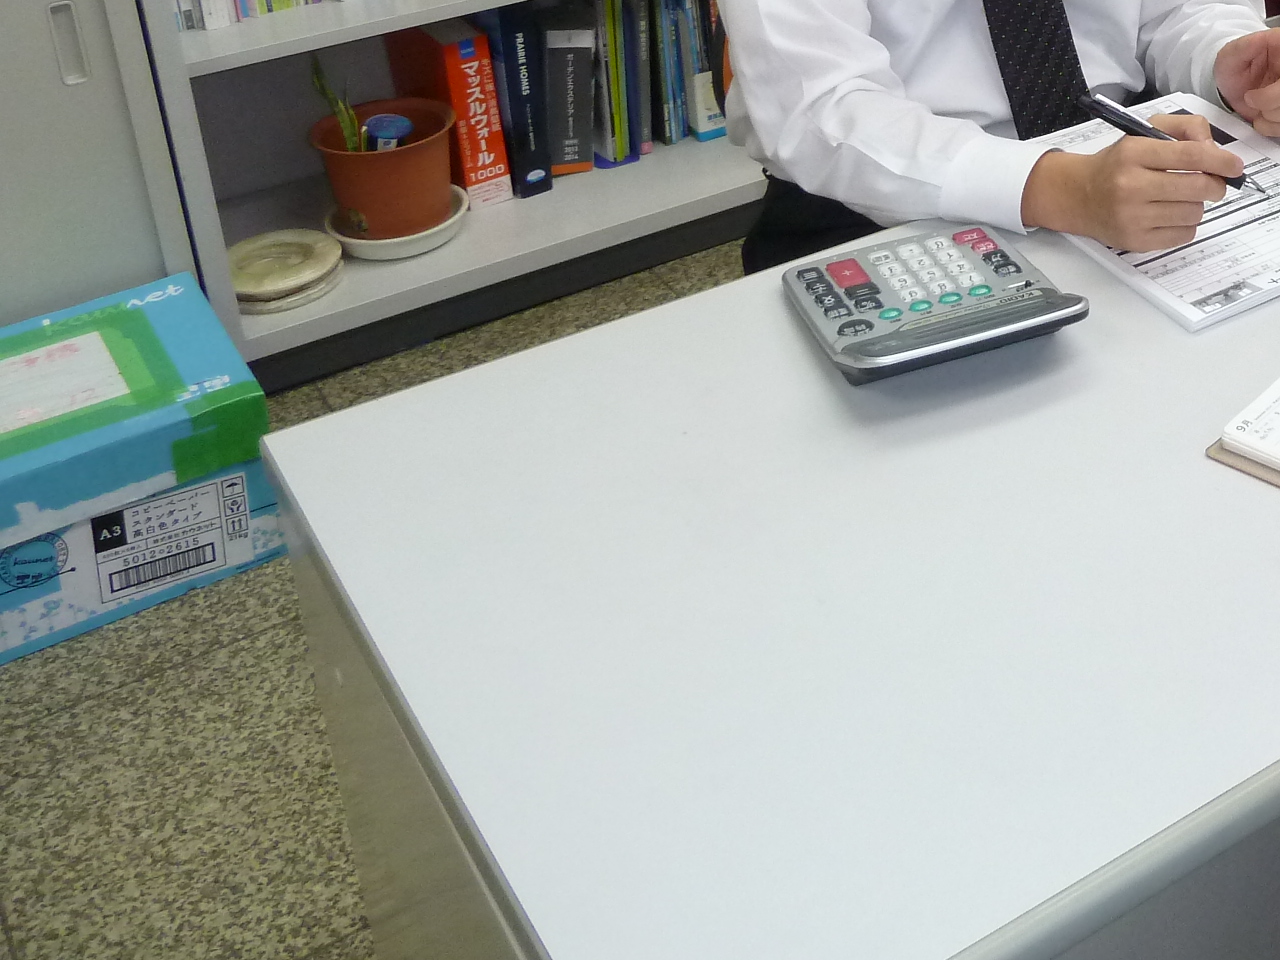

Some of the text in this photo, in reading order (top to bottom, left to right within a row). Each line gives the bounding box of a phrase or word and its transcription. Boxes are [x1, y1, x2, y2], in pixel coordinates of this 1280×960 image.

[515, 32, 531, 96] PRAIRIE HOMES
[460, 60, 496, 168] マッスルウォール
[469, 164, 505, 182] 1000
[131, 490, 211, 518] コピーペーパー
[132, 502, 199, 528] スタンダード
[99, 525, 122, 541] A3
[132, 511, 203, 539] 高白色タイプ
